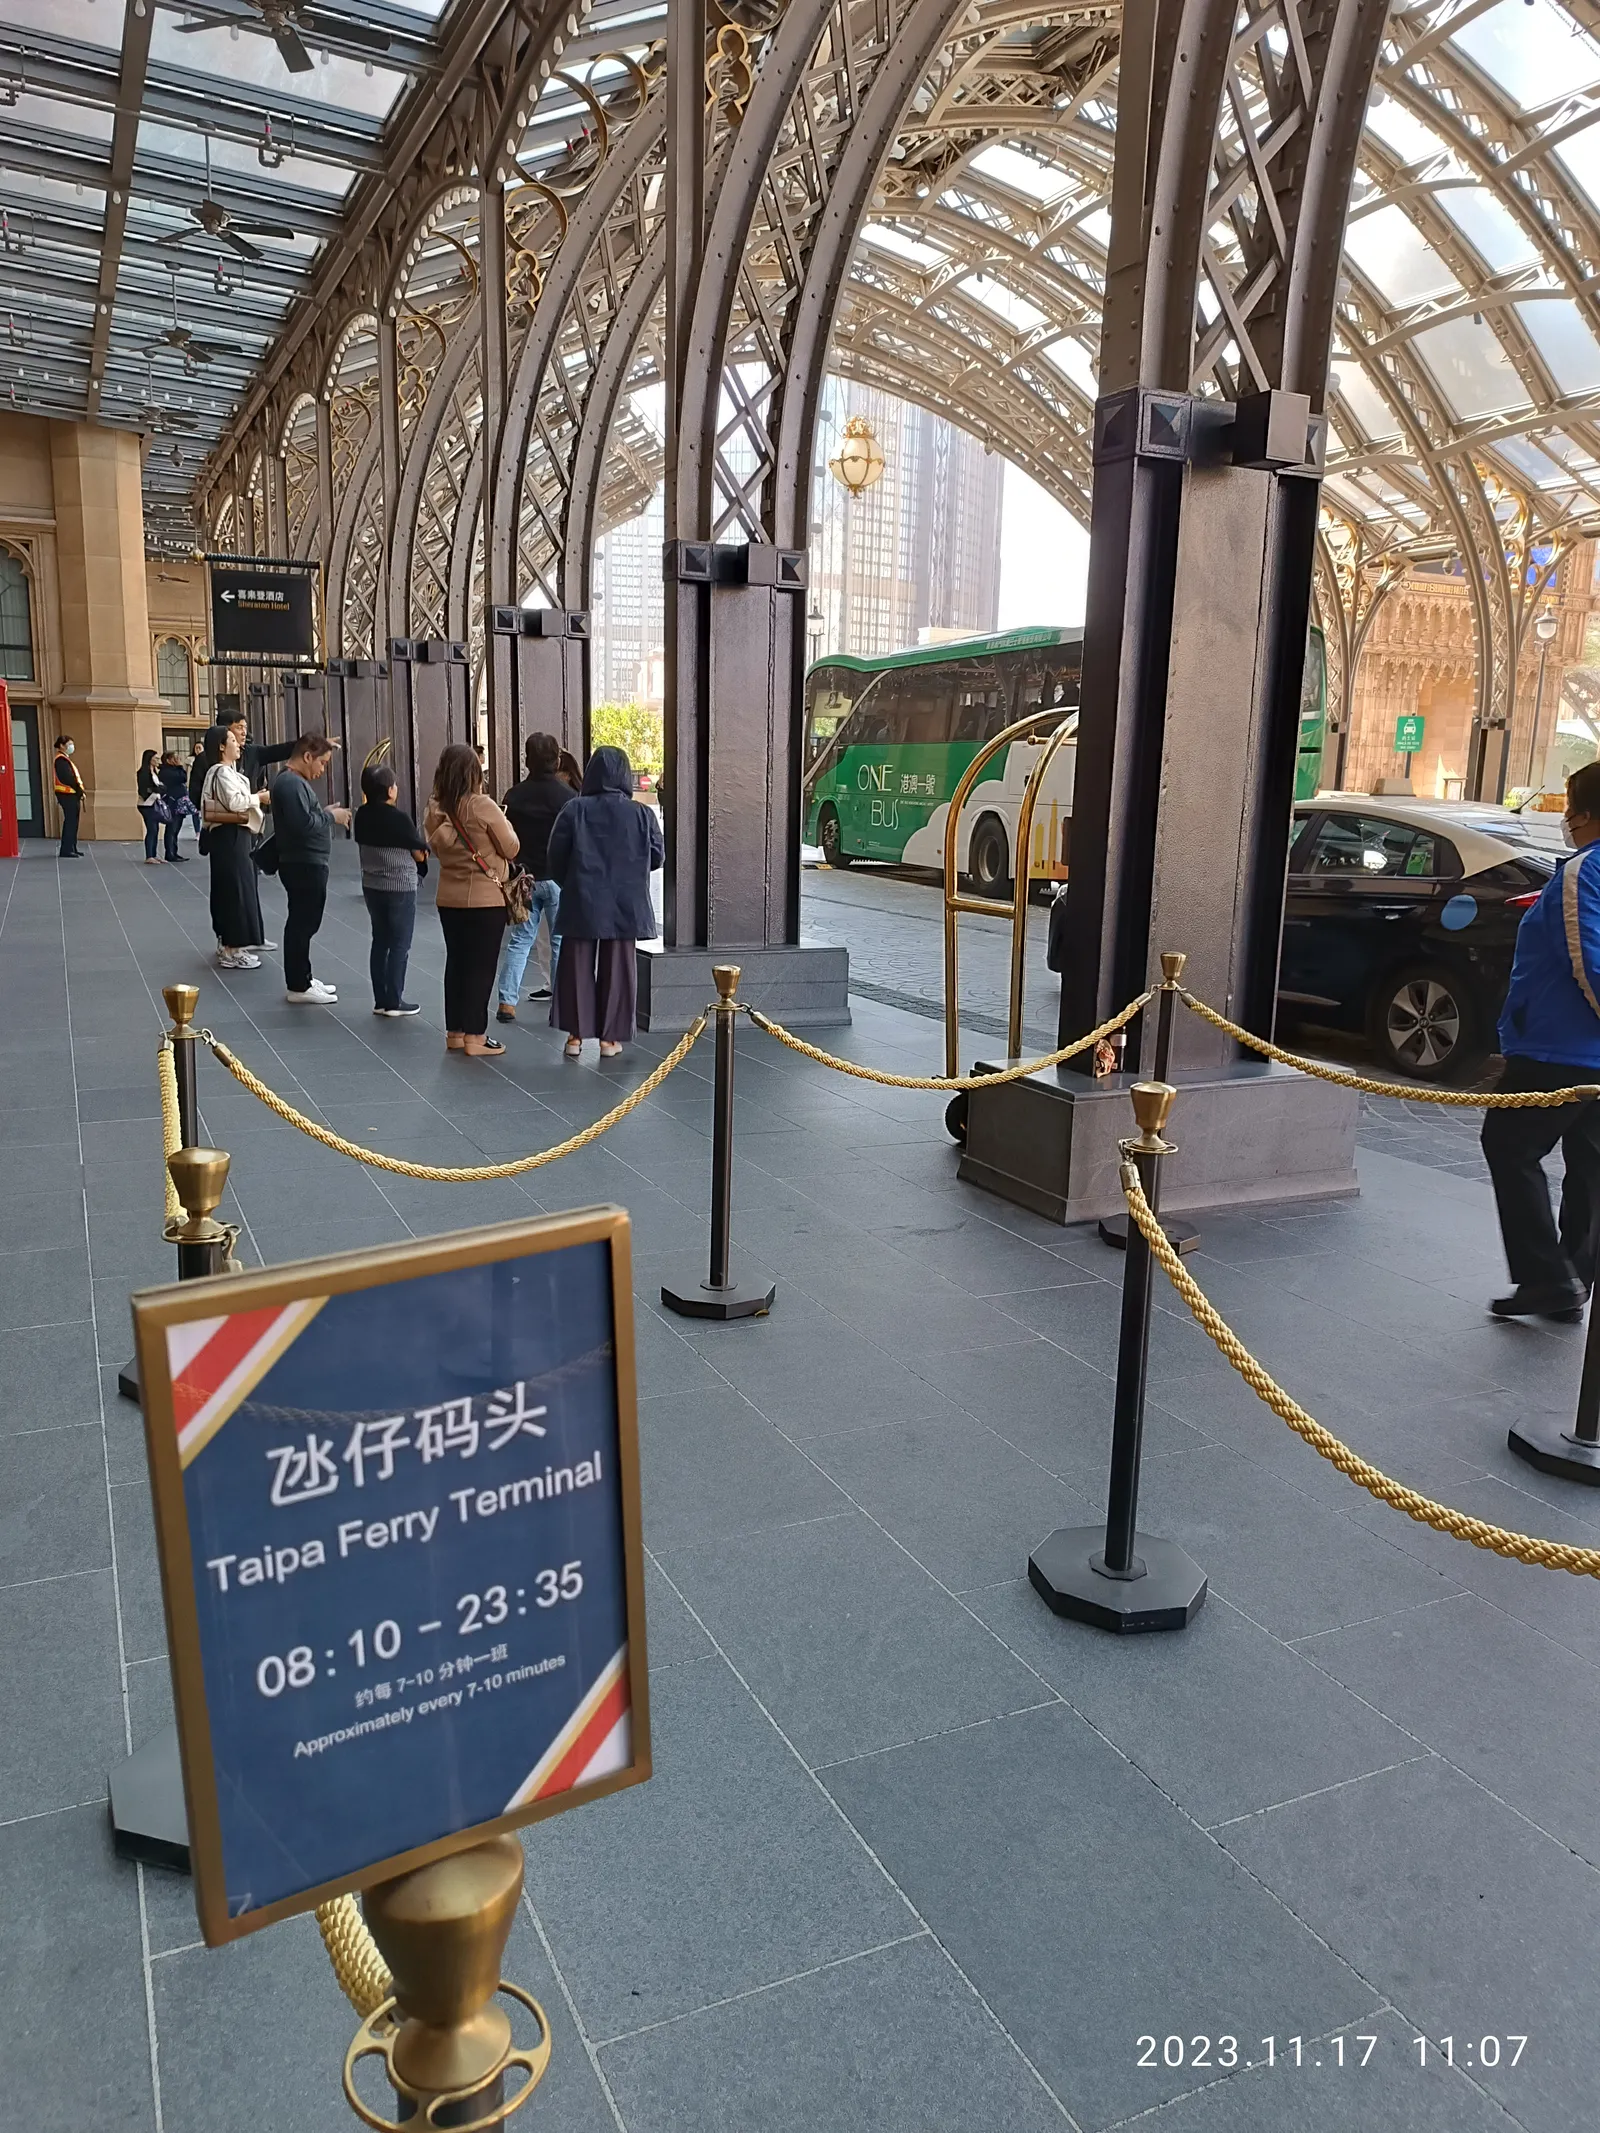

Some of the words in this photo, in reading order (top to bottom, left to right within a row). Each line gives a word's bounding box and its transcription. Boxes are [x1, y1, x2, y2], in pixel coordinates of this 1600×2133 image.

[271, 602, 290, 610] Hotel
[871, 799, 899, 830] BUS
[266, 1381, 547, 1506] 氹仔码头
[206, 1539, 326, 1593] Taipa
[338, 1506, 440, 1557] Ferry
[449, 1450, 602, 1523] Terminal
[294, 1707, 414, 1758] Approximately
[417, 1689, 462, 1715] every
[466, 1674, 502, 1698] 7-10
[505, 1655, 567, 1683] minutes
[355, 1681, 392, 1707] 约每
[439, 1643, 509, 1681] 分钟一班
